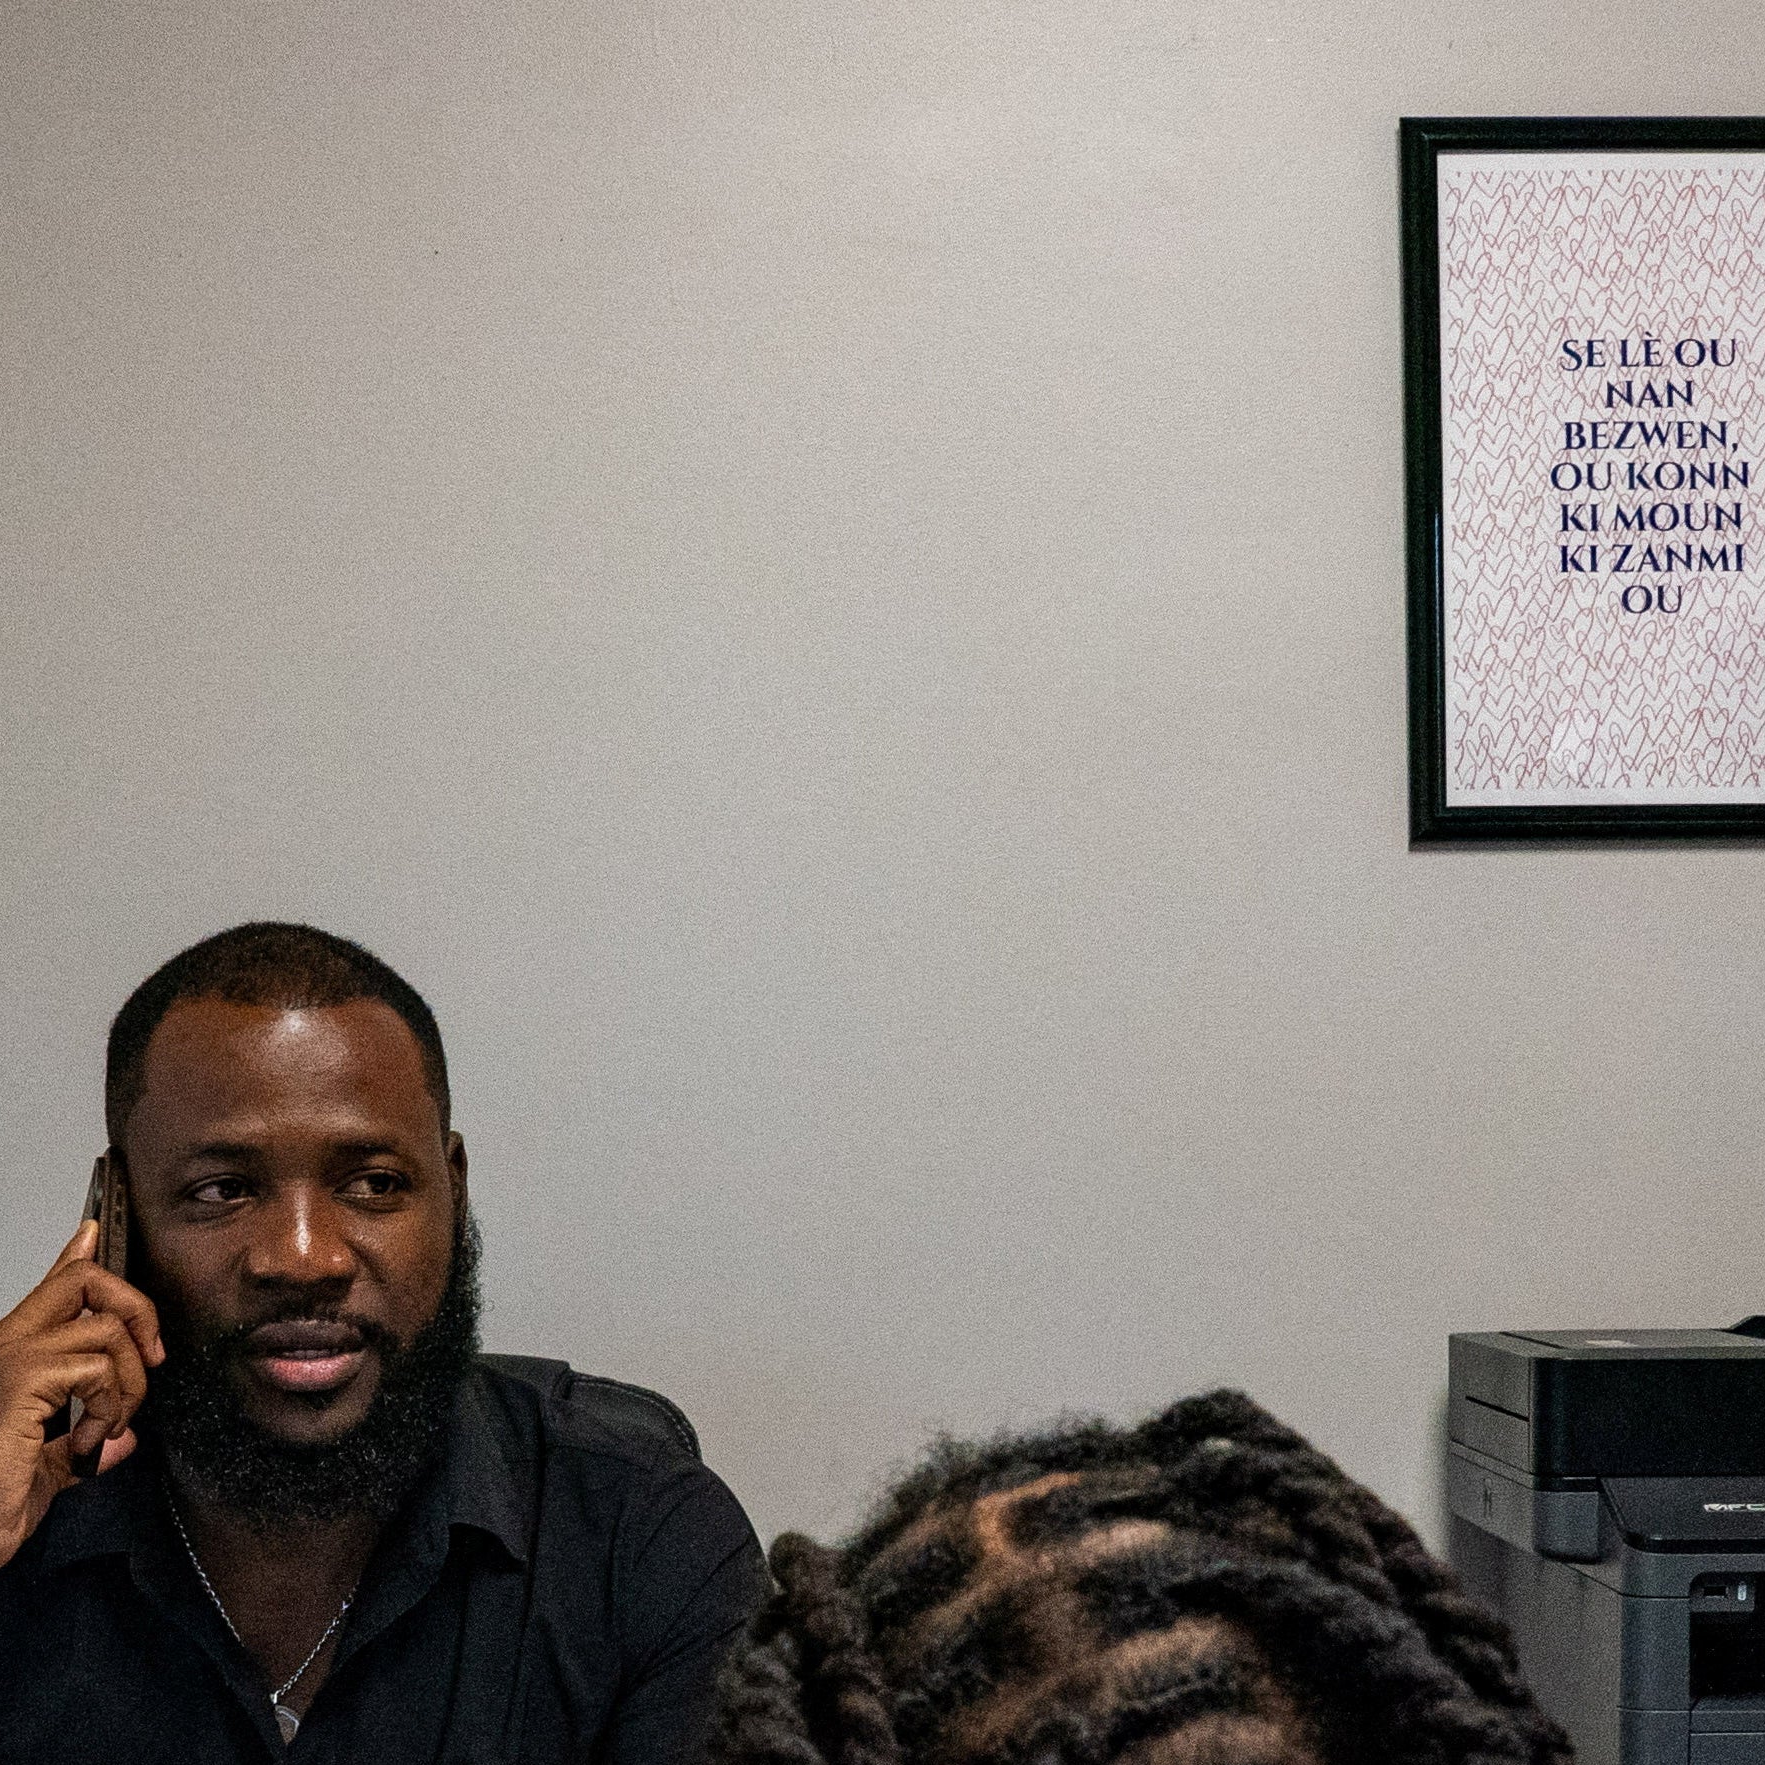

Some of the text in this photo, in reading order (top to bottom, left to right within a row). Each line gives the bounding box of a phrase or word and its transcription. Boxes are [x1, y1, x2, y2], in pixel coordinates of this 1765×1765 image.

[1562, 331, 1736, 371] SE LÈ OU
[1606, 380, 1692, 408] NAN
[1565, 421, 1738, 454] BEZWEN,
[1551, 462, 1748, 491] OU KONN
[1562, 503, 1741, 532] KI MOUN
[1561, 544, 1743, 573] KI ZANMI
[1622, 585, 1682, 613] OU
